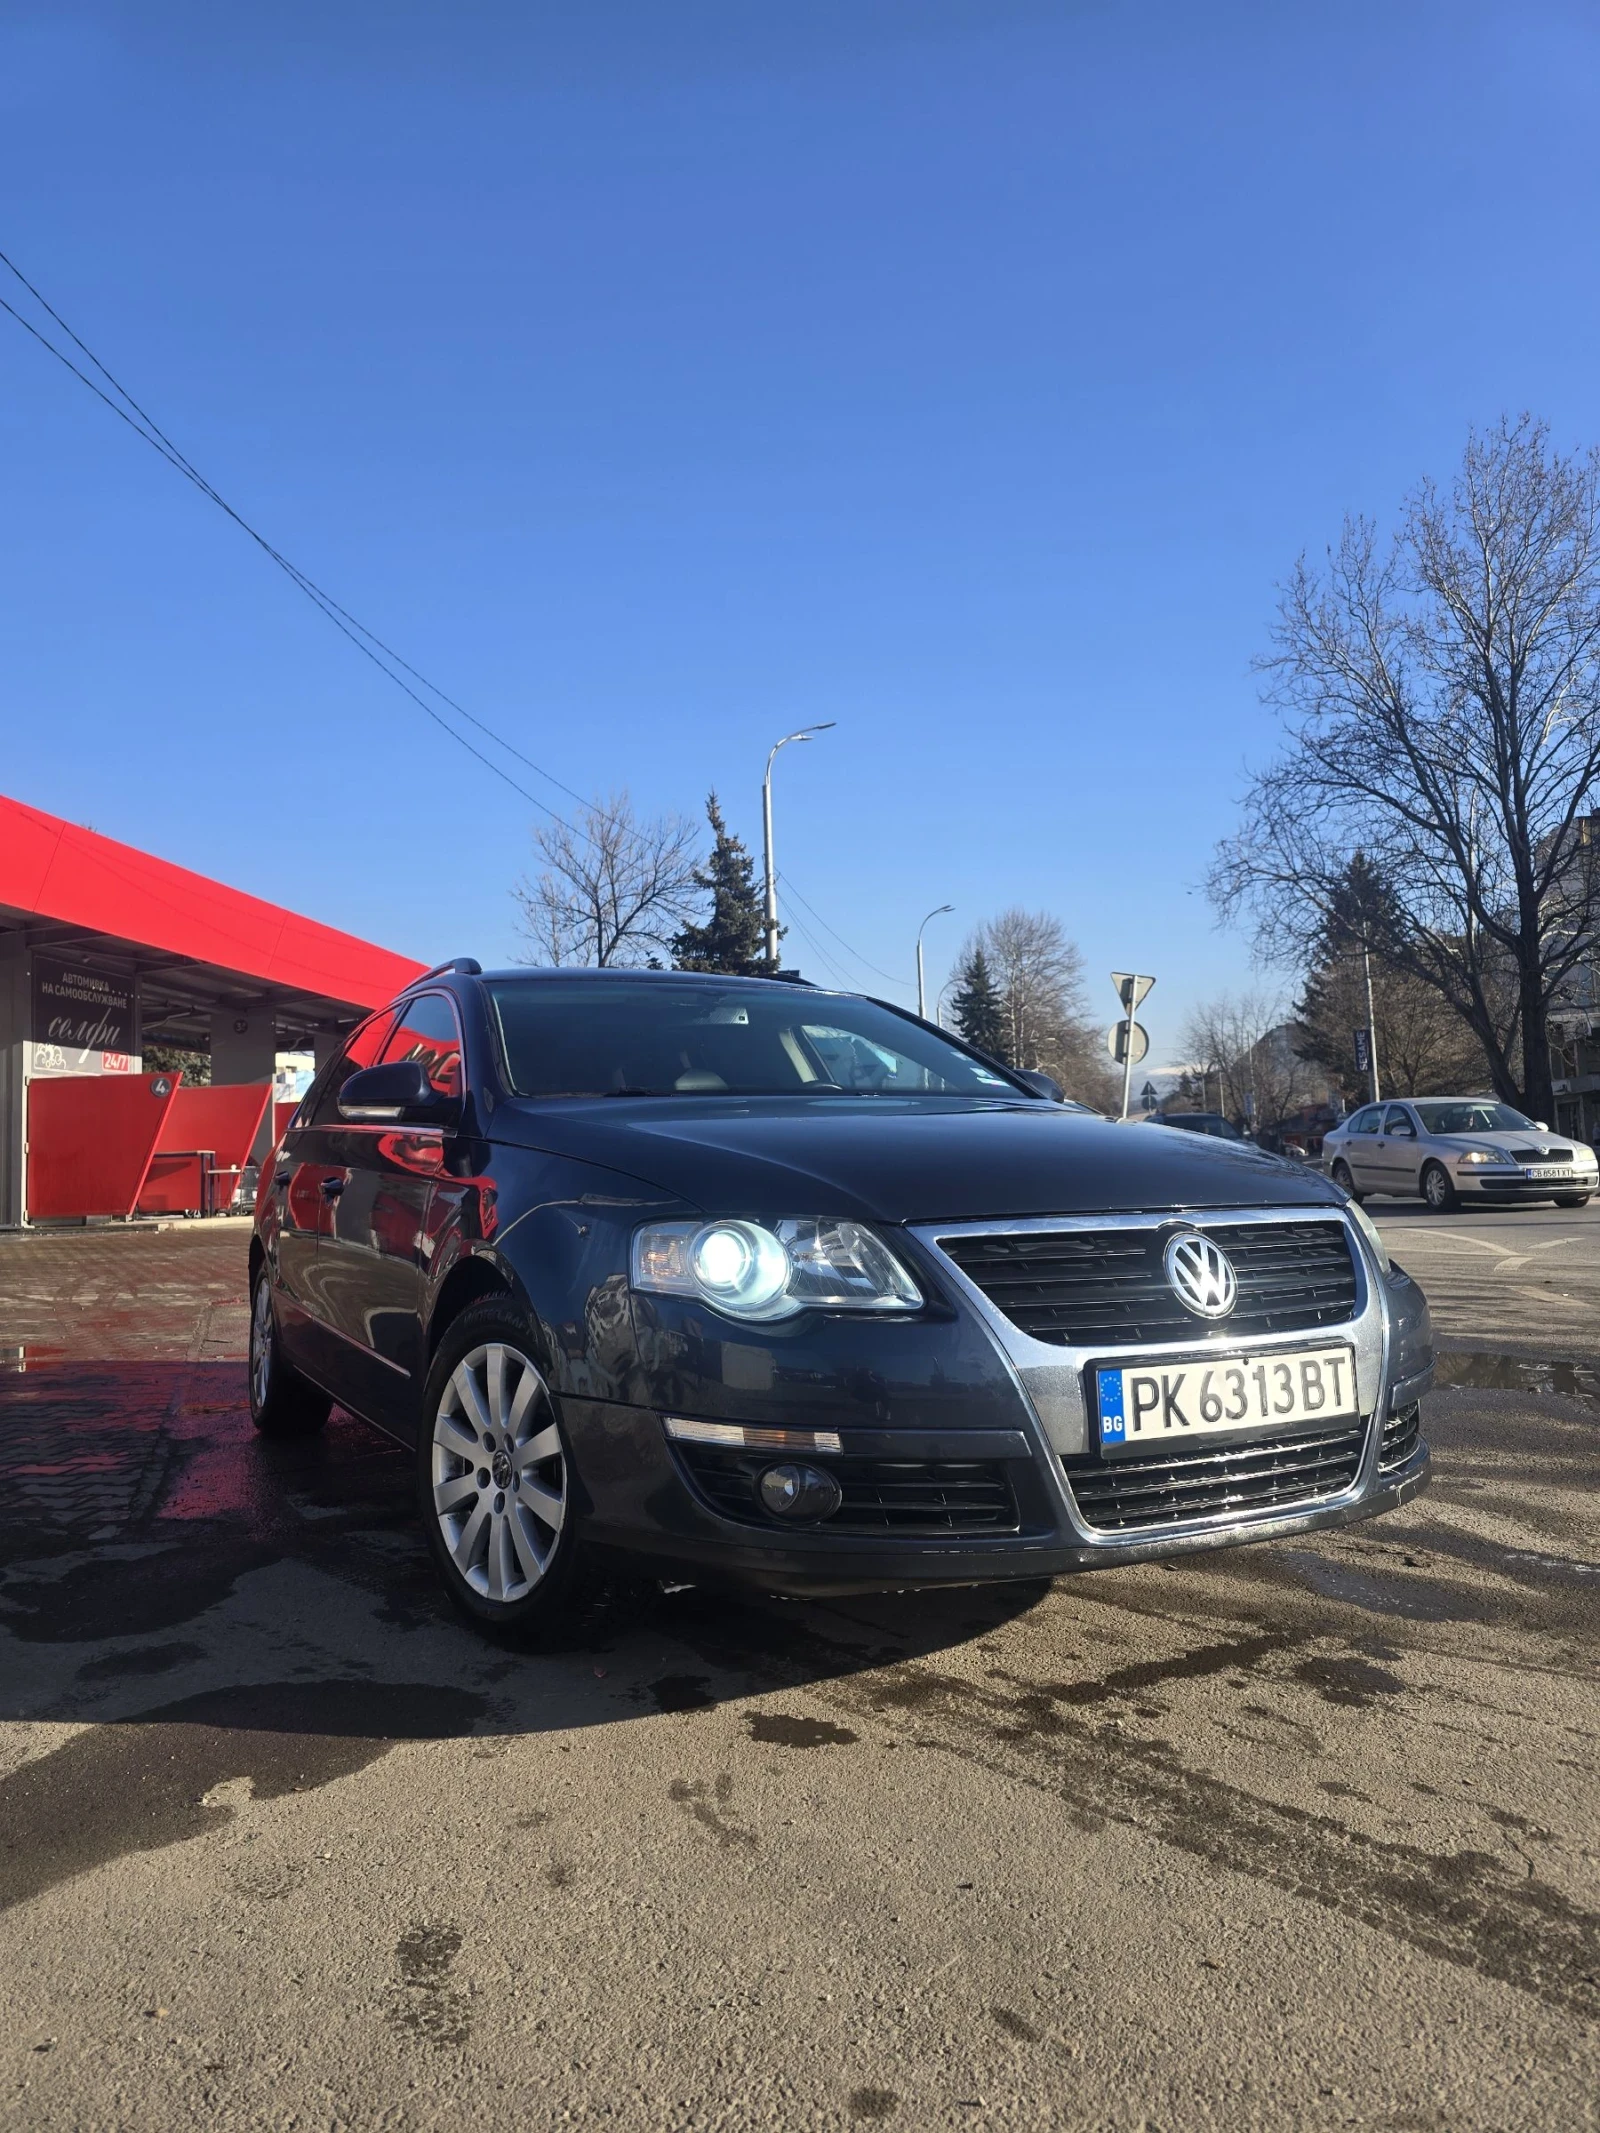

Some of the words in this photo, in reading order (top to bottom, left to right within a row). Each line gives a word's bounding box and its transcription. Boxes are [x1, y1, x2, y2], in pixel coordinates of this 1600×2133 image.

[62, 972, 110, 992] АВТОМИВКА
[42, 982, 54, 994] НА
[54, 984, 127, 1009] САМООБСЛУЖВАНЕ
[48, 1007, 120, 1064] селфи
[104, 1052, 127, 1070] 24/7
[1357, 1031, 1368, 1071] SESAME
[155, 1080, 166, 1094] 4
[1103, 1416, 1123, 1433] BG
